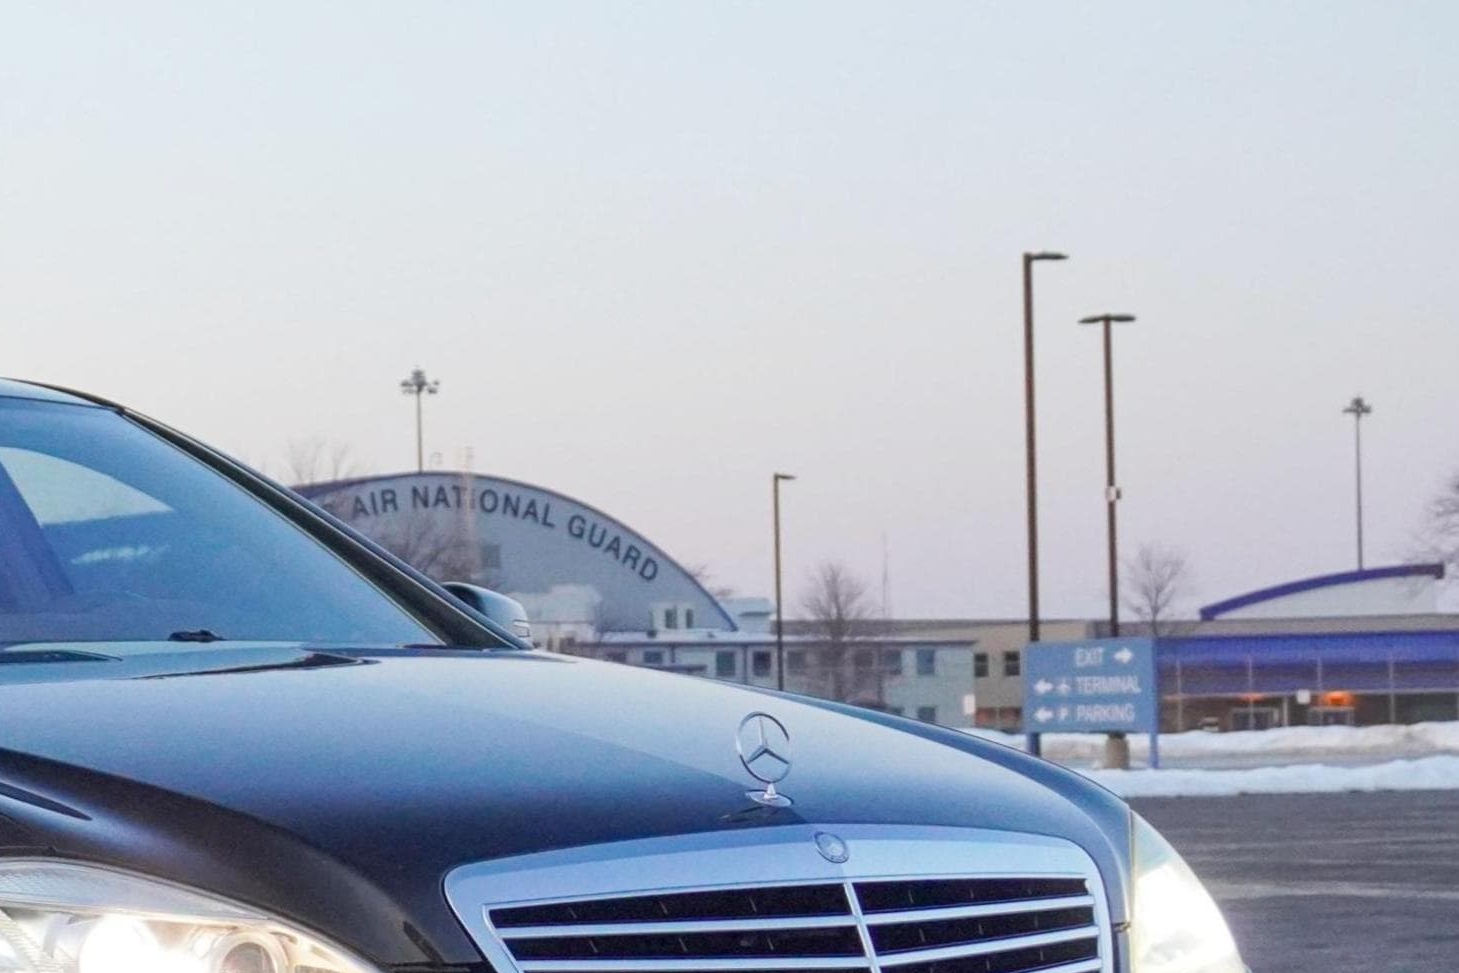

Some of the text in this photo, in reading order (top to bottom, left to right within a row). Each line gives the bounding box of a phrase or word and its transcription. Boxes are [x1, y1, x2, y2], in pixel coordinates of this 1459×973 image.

[351, 488, 399, 519] AIR
[411, 485, 557, 529] NATIONAL
[567, 513, 660, 583] GUARD
[1074, 647, 1104, 668] EXIT
[1075, 675, 1142, 694] TERMINAL
[1075, 703, 1136, 723] PARKING
